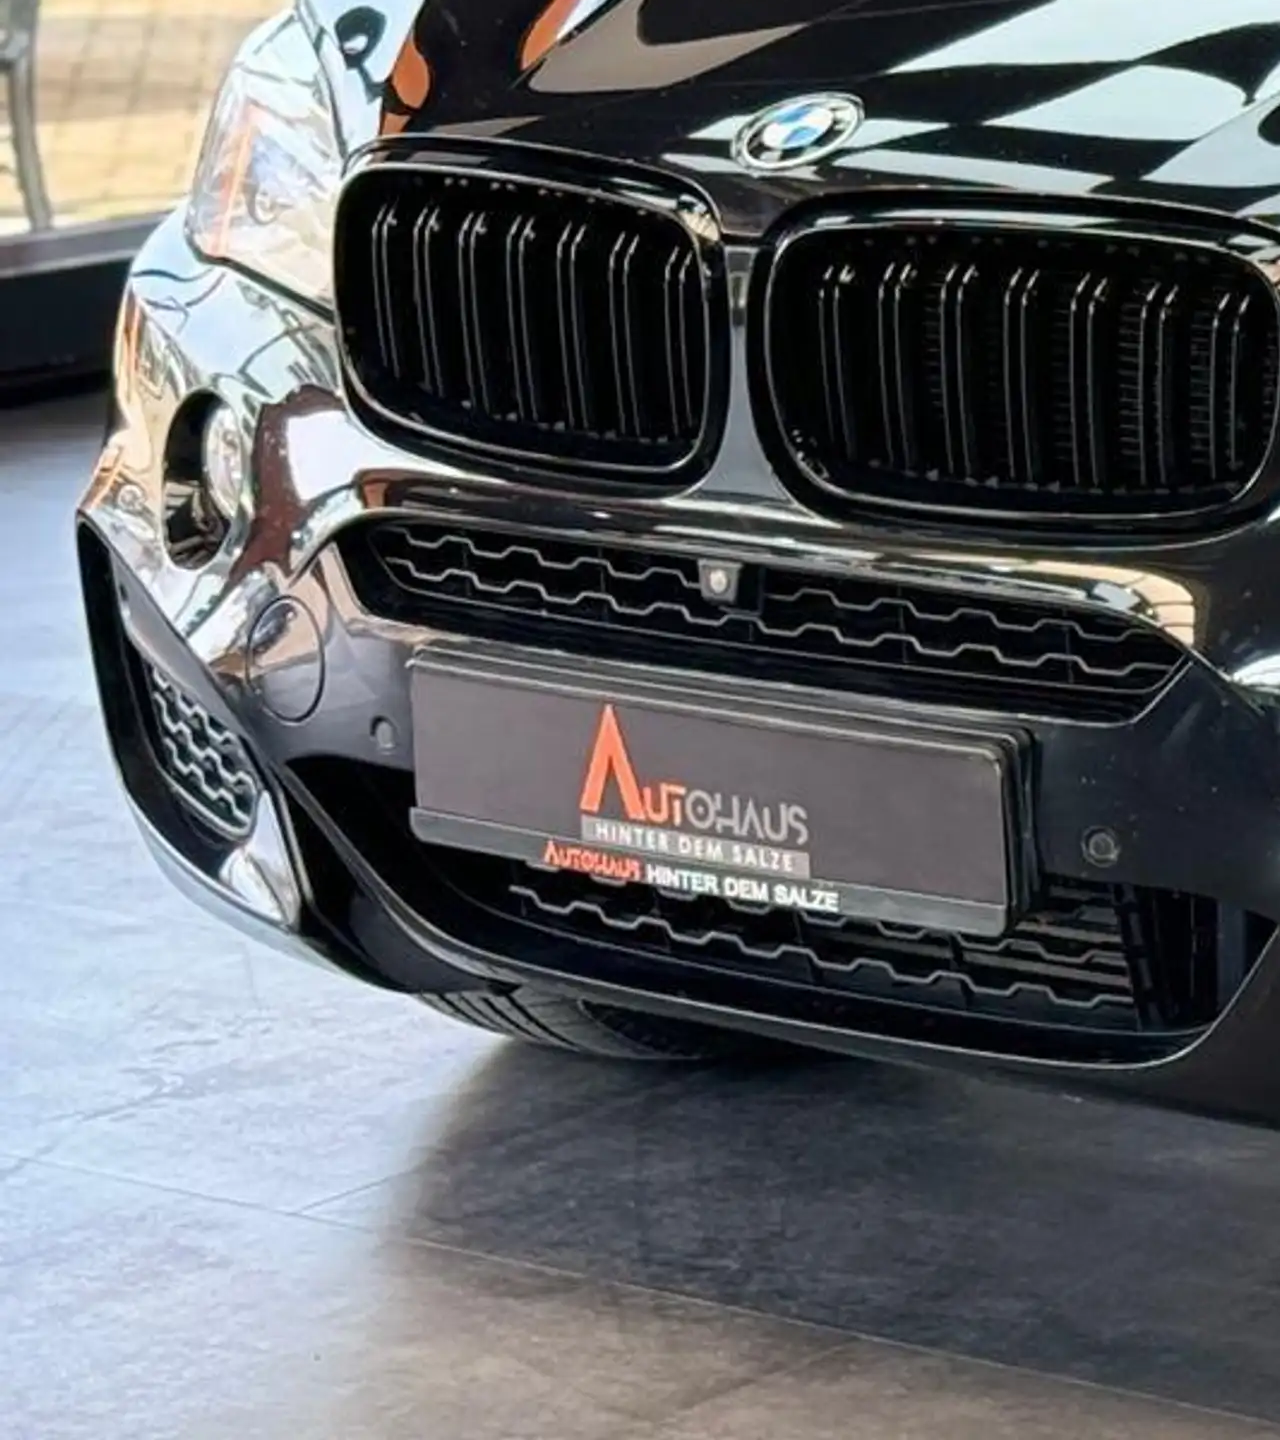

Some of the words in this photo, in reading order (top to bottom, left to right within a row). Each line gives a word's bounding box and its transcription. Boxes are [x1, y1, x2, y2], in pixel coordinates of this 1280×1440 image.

[579, 703, 809, 846] AUTOHAUS
[594, 822, 669, 851] HINTER
[678, 837, 723, 861] DEM
[732, 846, 794, 873] SALZE
[646, 863, 718, 896] HINTER
[723, 875, 770, 903] DEM
[772, 884, 840, 912] SALZE
